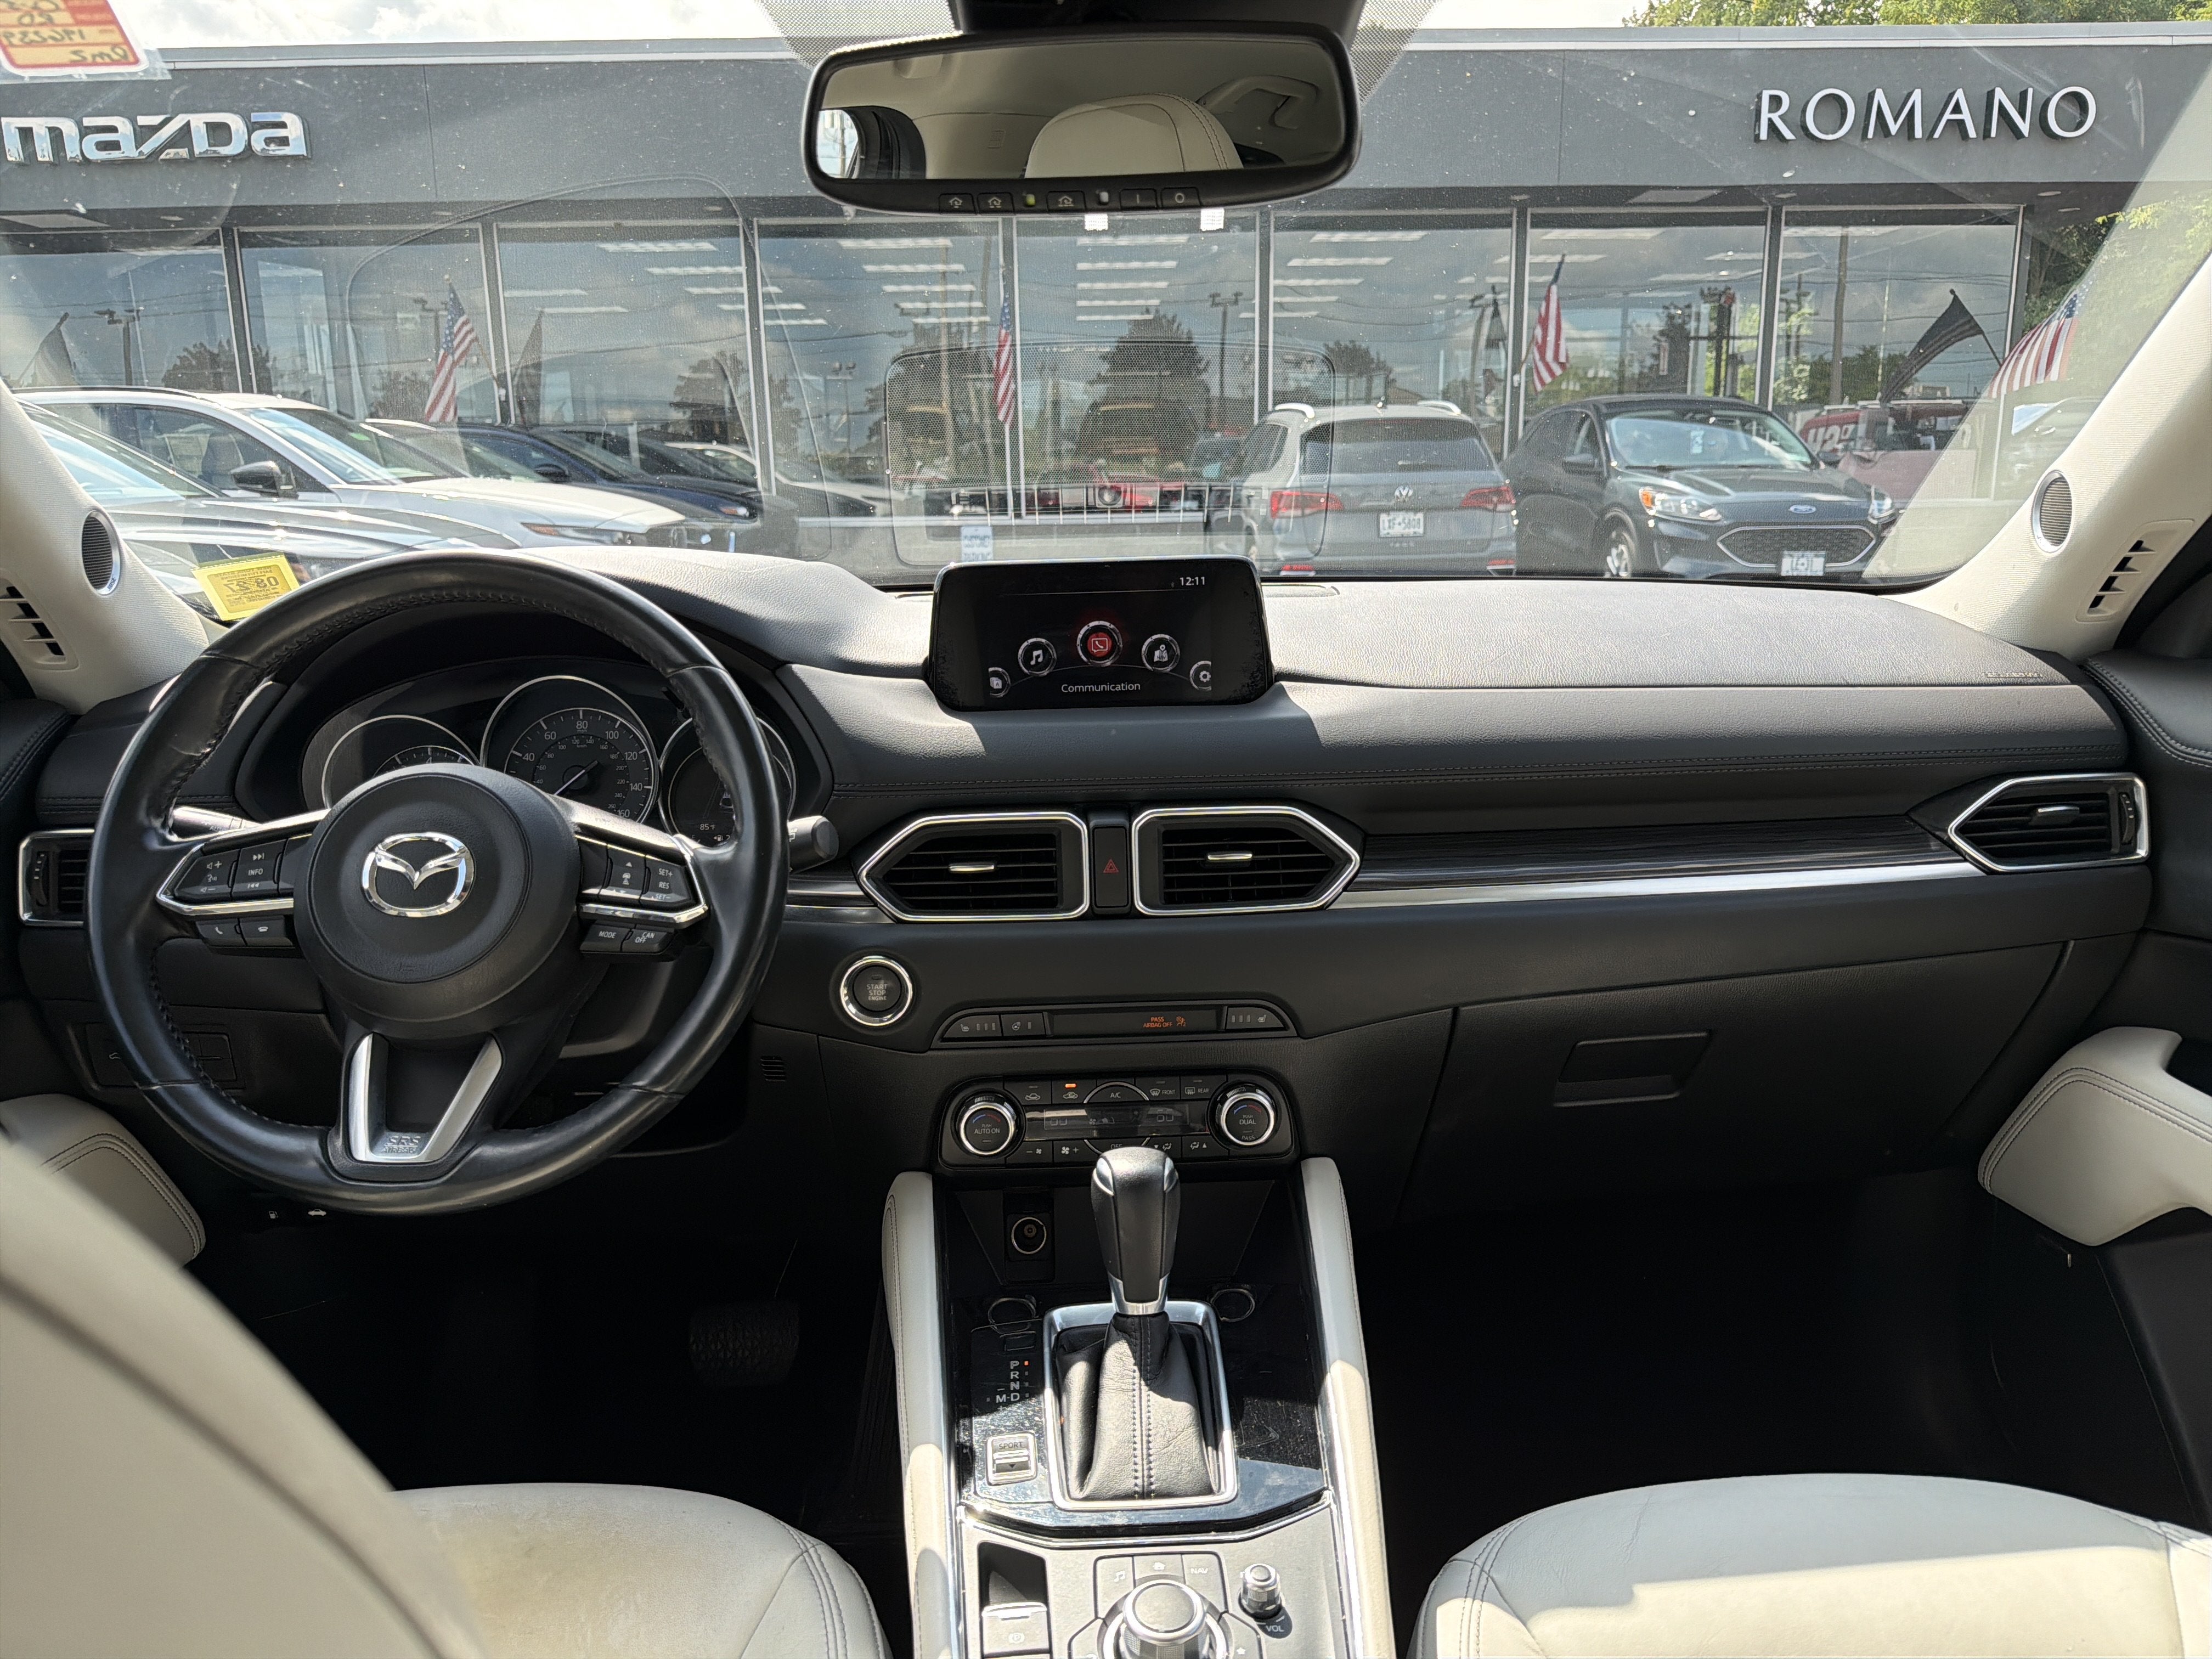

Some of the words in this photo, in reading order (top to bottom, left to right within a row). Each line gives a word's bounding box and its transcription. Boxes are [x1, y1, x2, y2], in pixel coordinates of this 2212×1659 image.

[1757, 86, 2097, 140] ROMANO
[1179, 576, 1206, 586] 12:11
[1060, 682, 1141, 692] Communication
[576, 720, 588, 729] 80
[544, 731, 556, 740] 60
[605, 731, 619, 739] 100
[523, 753, 535, 761] 40
[624, 752, 637, 760] 120
[630, 783, 642, 791] 140
[617, 809, 630, 817] 160
[658, 868, 673, 877] SET+
[659, 881, 669, 889] RES
[385, 1136, 421, 1146] SRS
[1010, 1361, 1019, 1369] P
[1010, 1371, 1019, 1379] R
[1010, 1381, 1019, 1390] N
[998, 1441, 1023, 1449] SPORT
